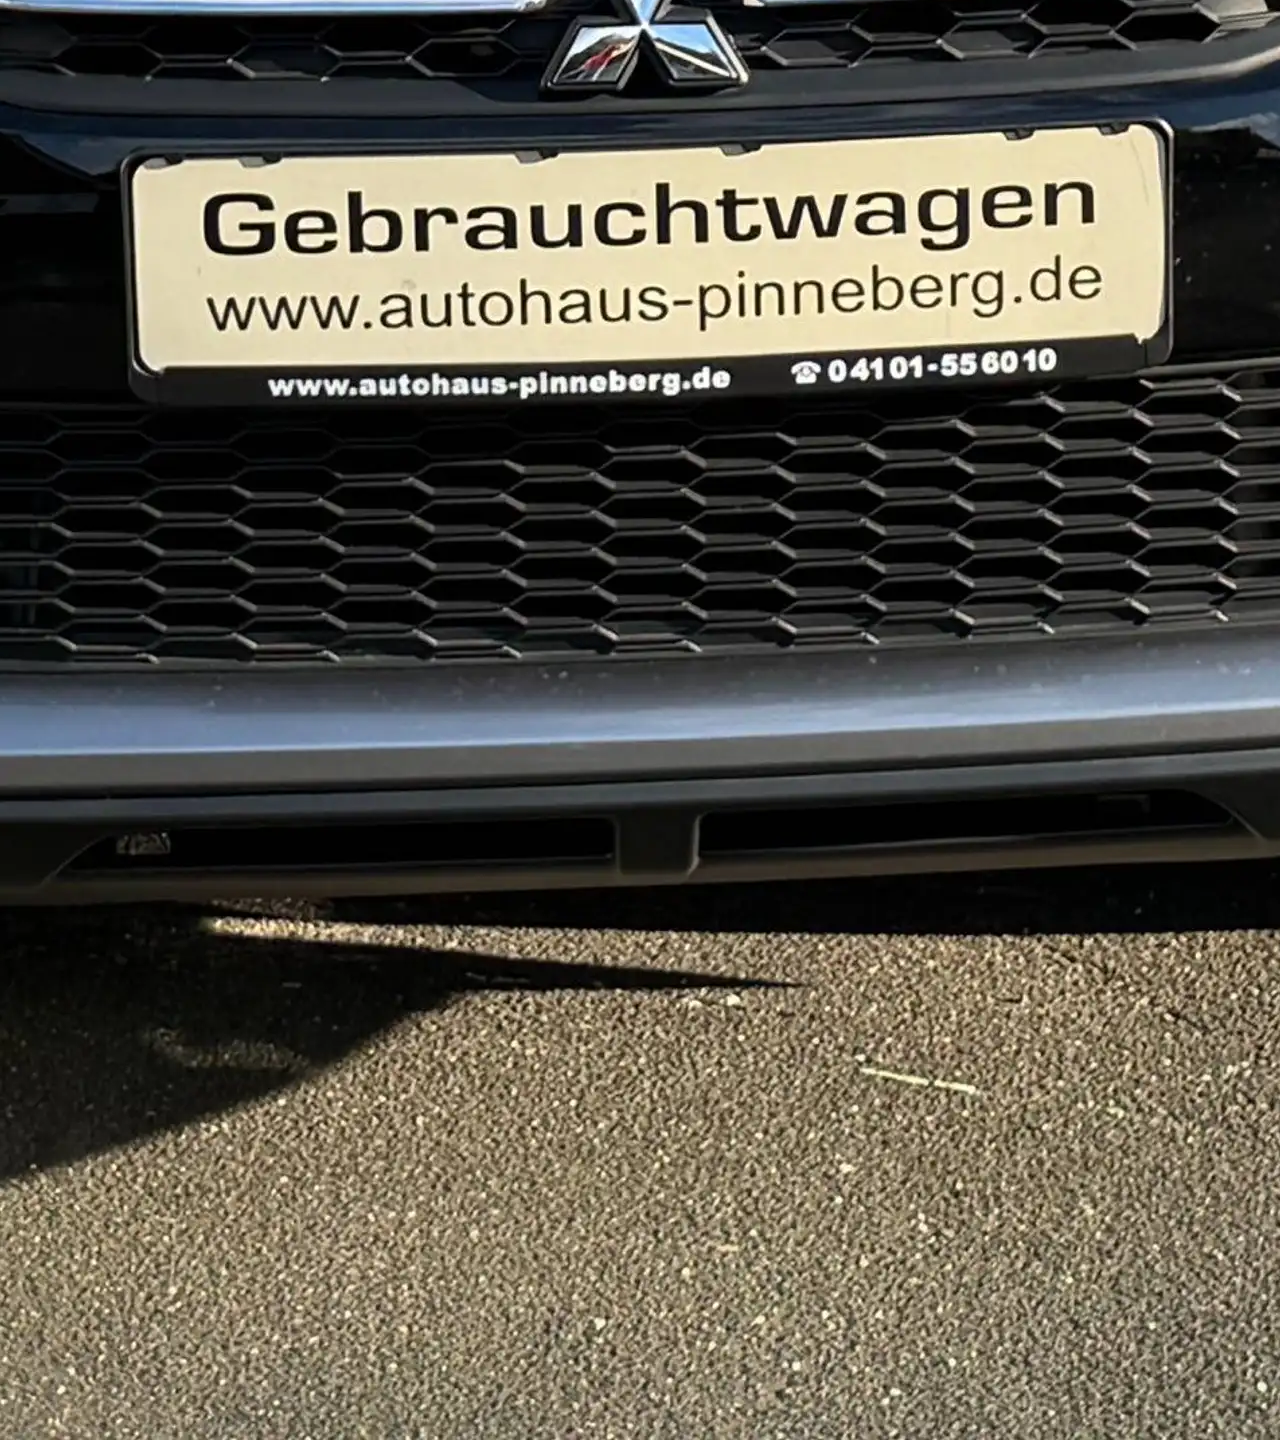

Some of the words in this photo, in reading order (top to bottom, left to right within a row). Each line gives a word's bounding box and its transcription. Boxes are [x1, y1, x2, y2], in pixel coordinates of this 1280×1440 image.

[203, 179, 1096, 256] Gebrauchtwagen
[207, 254, 1103, 332] www.autohaus-pinneberg.de
[267, 365, 732, 398] www.autohaus-pinneberg.de
